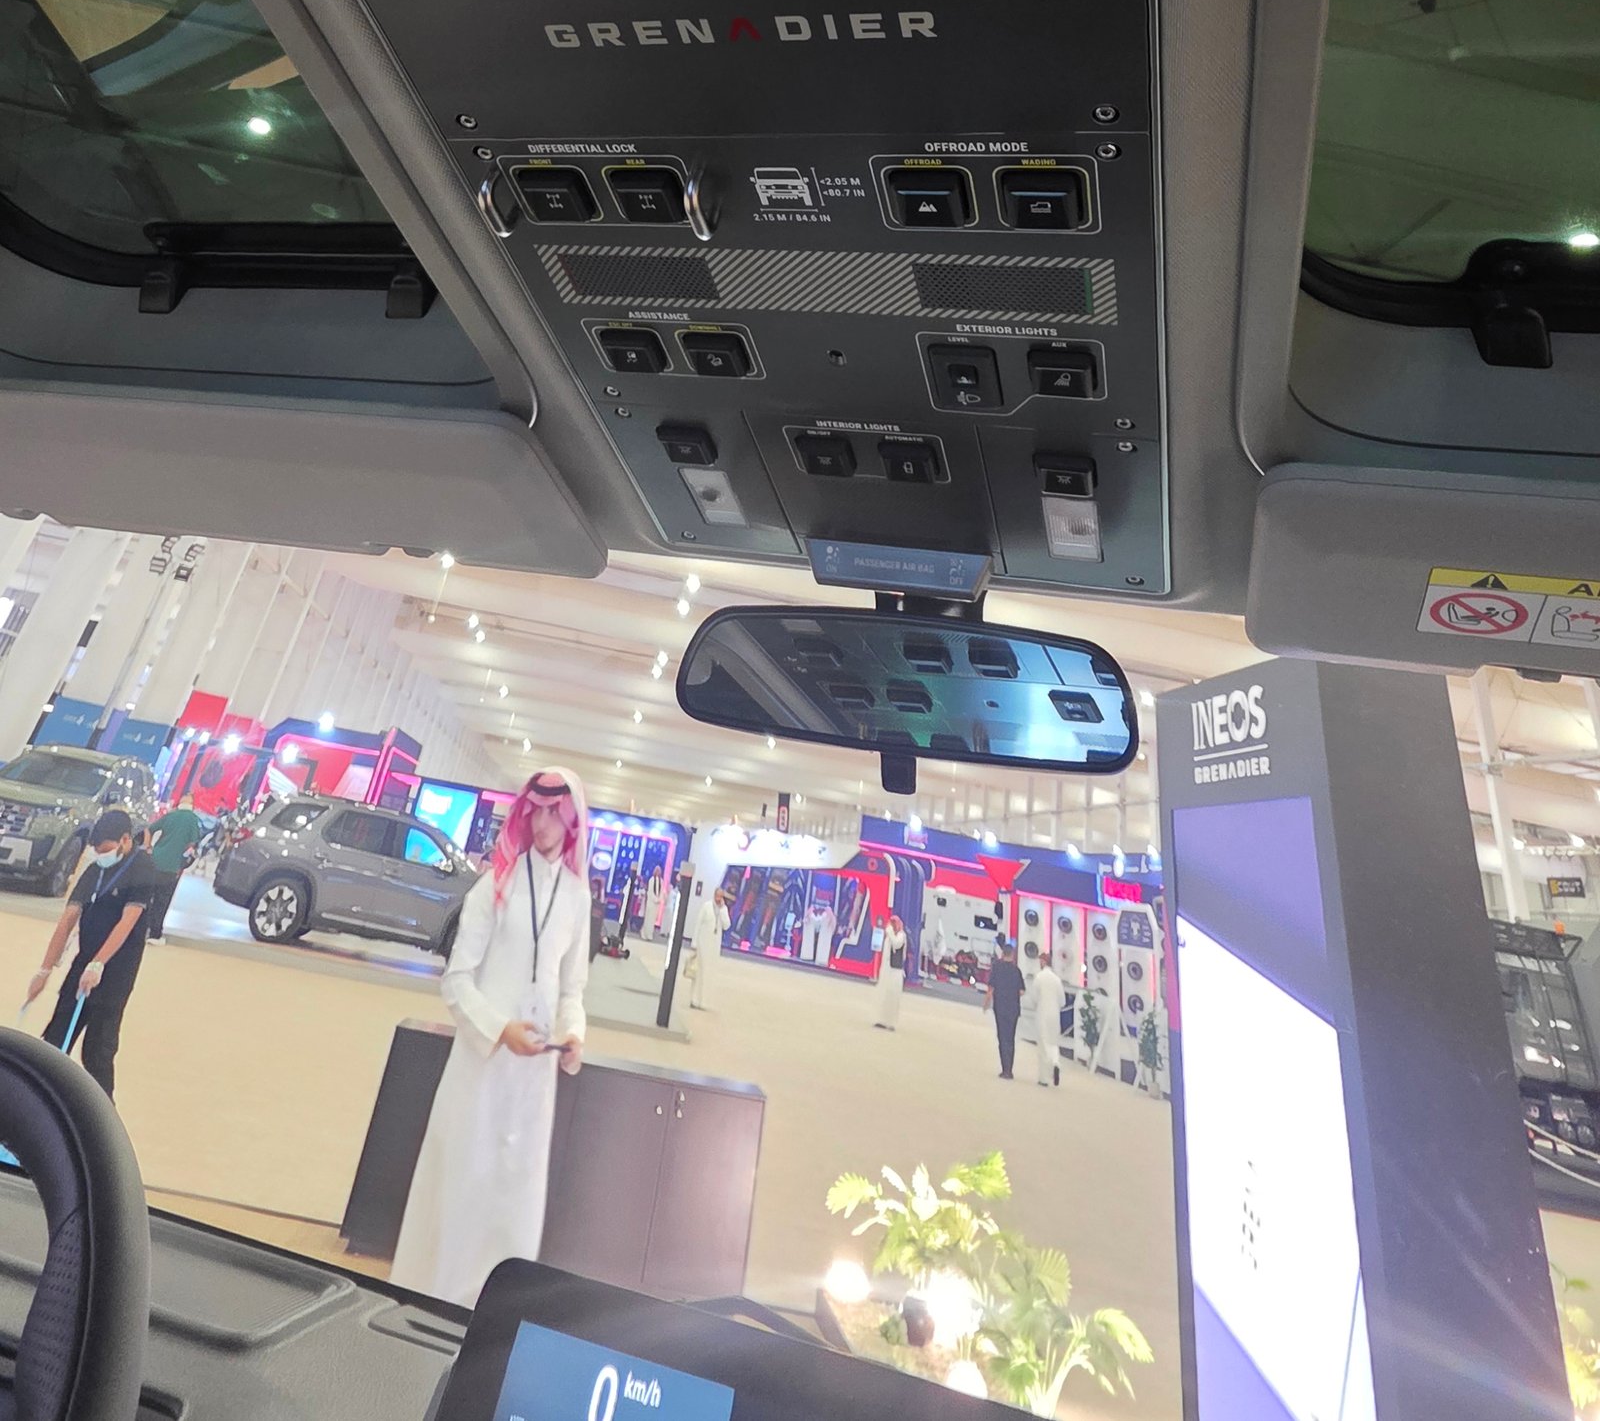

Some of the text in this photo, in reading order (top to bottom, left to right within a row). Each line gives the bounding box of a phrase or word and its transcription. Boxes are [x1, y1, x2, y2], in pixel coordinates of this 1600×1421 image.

[544, 11, 938, 48] GRENADIER
[527, 143, 638, 154] DIFFERENTIAL LOCK
[924, 142, 1029, 153] OFFROAD MODE
[903, 158, 942, 166] OFFROAD
[1021, 158, 1056, 166] WADING
[850, 177, 861, 186] M
[853, 188, 866, 197] IN
[776, 213, 787, 221] M
[819, 214, 831, 222] IN
[628, 311, 690, 321] ASSISTANCE
[956, 324, 1058, 336] EXTERIOR LIGHTS
[815, 420, 900, 432] INTERIOR LIGHTS
[1191, 684, 1267, 750] INEOS
[1194, 756, 1271, 784] GRENADIER
[623, 1371, 663, 1408] km/h
